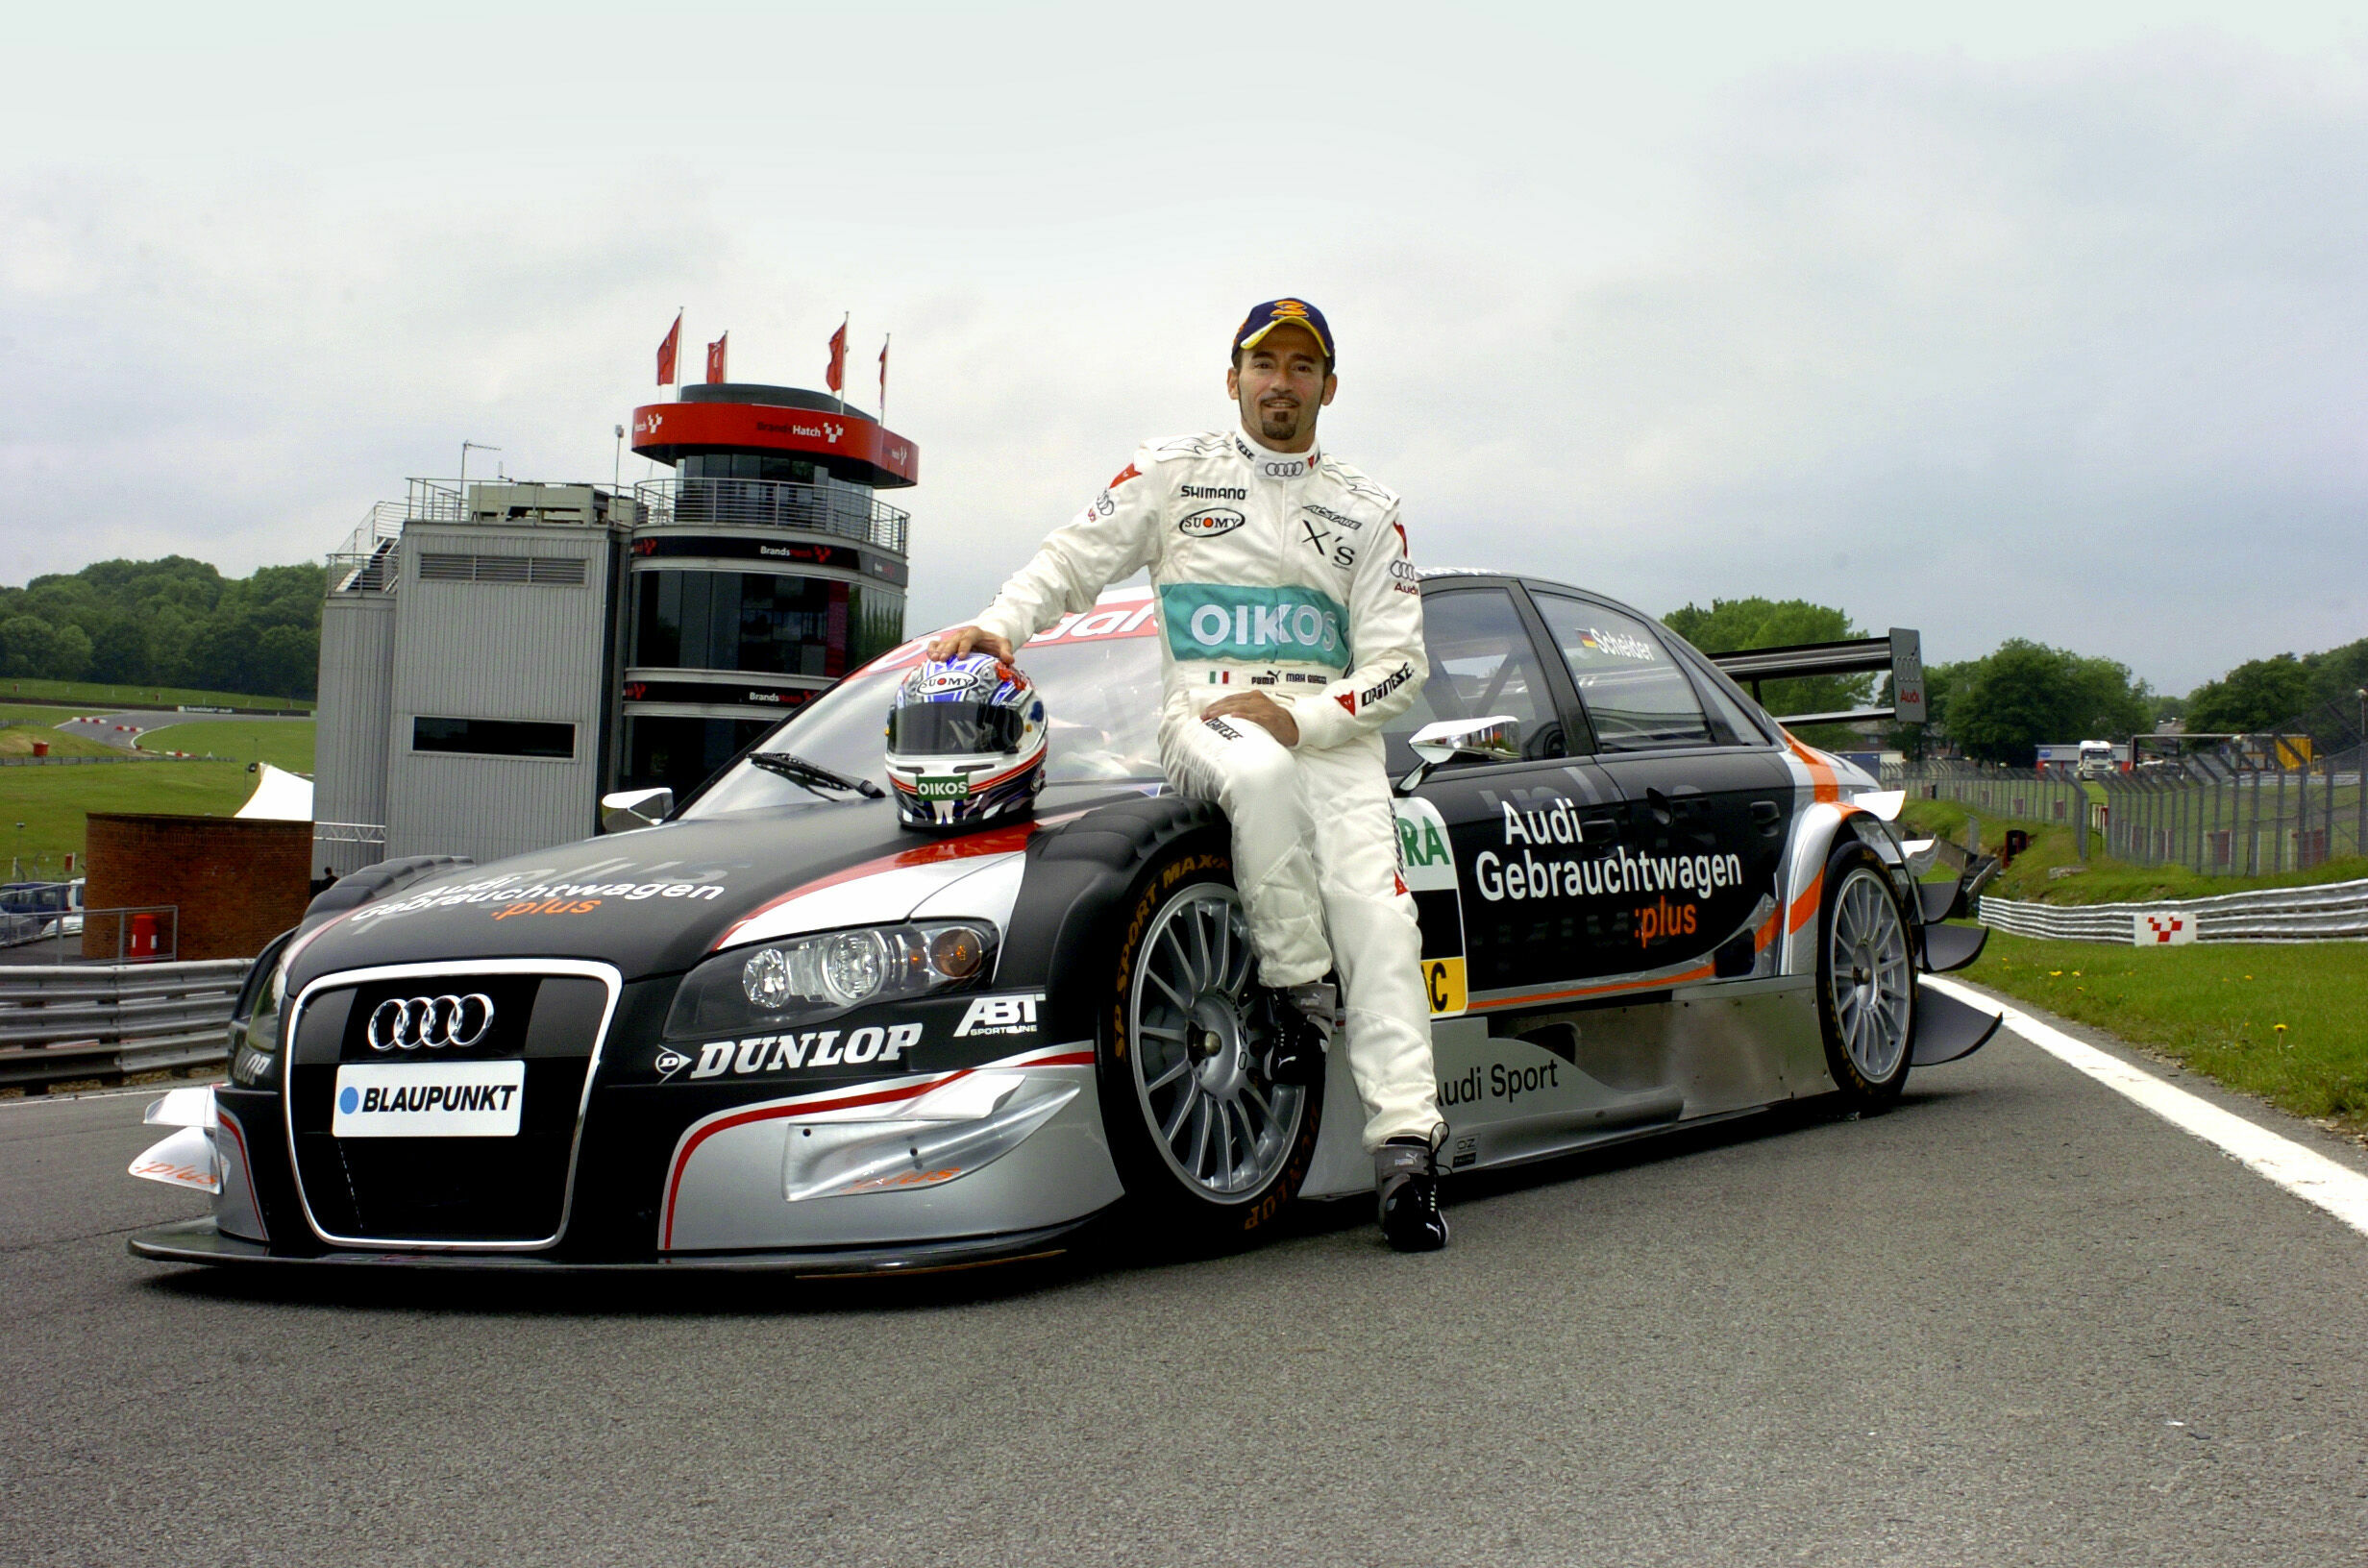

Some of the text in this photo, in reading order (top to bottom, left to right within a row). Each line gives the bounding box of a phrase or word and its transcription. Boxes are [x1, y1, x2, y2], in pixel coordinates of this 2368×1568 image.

[1180, 485, 1246, 500] SHIMANO
[1184, 517, 1240, 528] SUOMY
[1191, 603, 1337, 651] OIKOS
[1590, 627, 1655, 661] Scheider
[922, 677, 973, 689] SUOMY
[1900, 688, 1920, 703] Audi
[919, 780, 969, 796] OIKOS
[1395, 815, 1450, 867] RA
[1500, 797, 1584, 845] Audi
[1476, 846, 1742, 901] Gebrauchtwagen
[352, 882, 725, 922] Gebrauchtwagen
[1634, 895, 1696, 949] :plus
[1115, 884, 1157, 997] SPORT
[953, 993, 1047, 1038] ABT
[690, 1022, 924, 1079] DUNLOP
[361, 1085, 519, 1113] BLAUPUNKT
[1491, 1059, 1559, 1103] Sport
